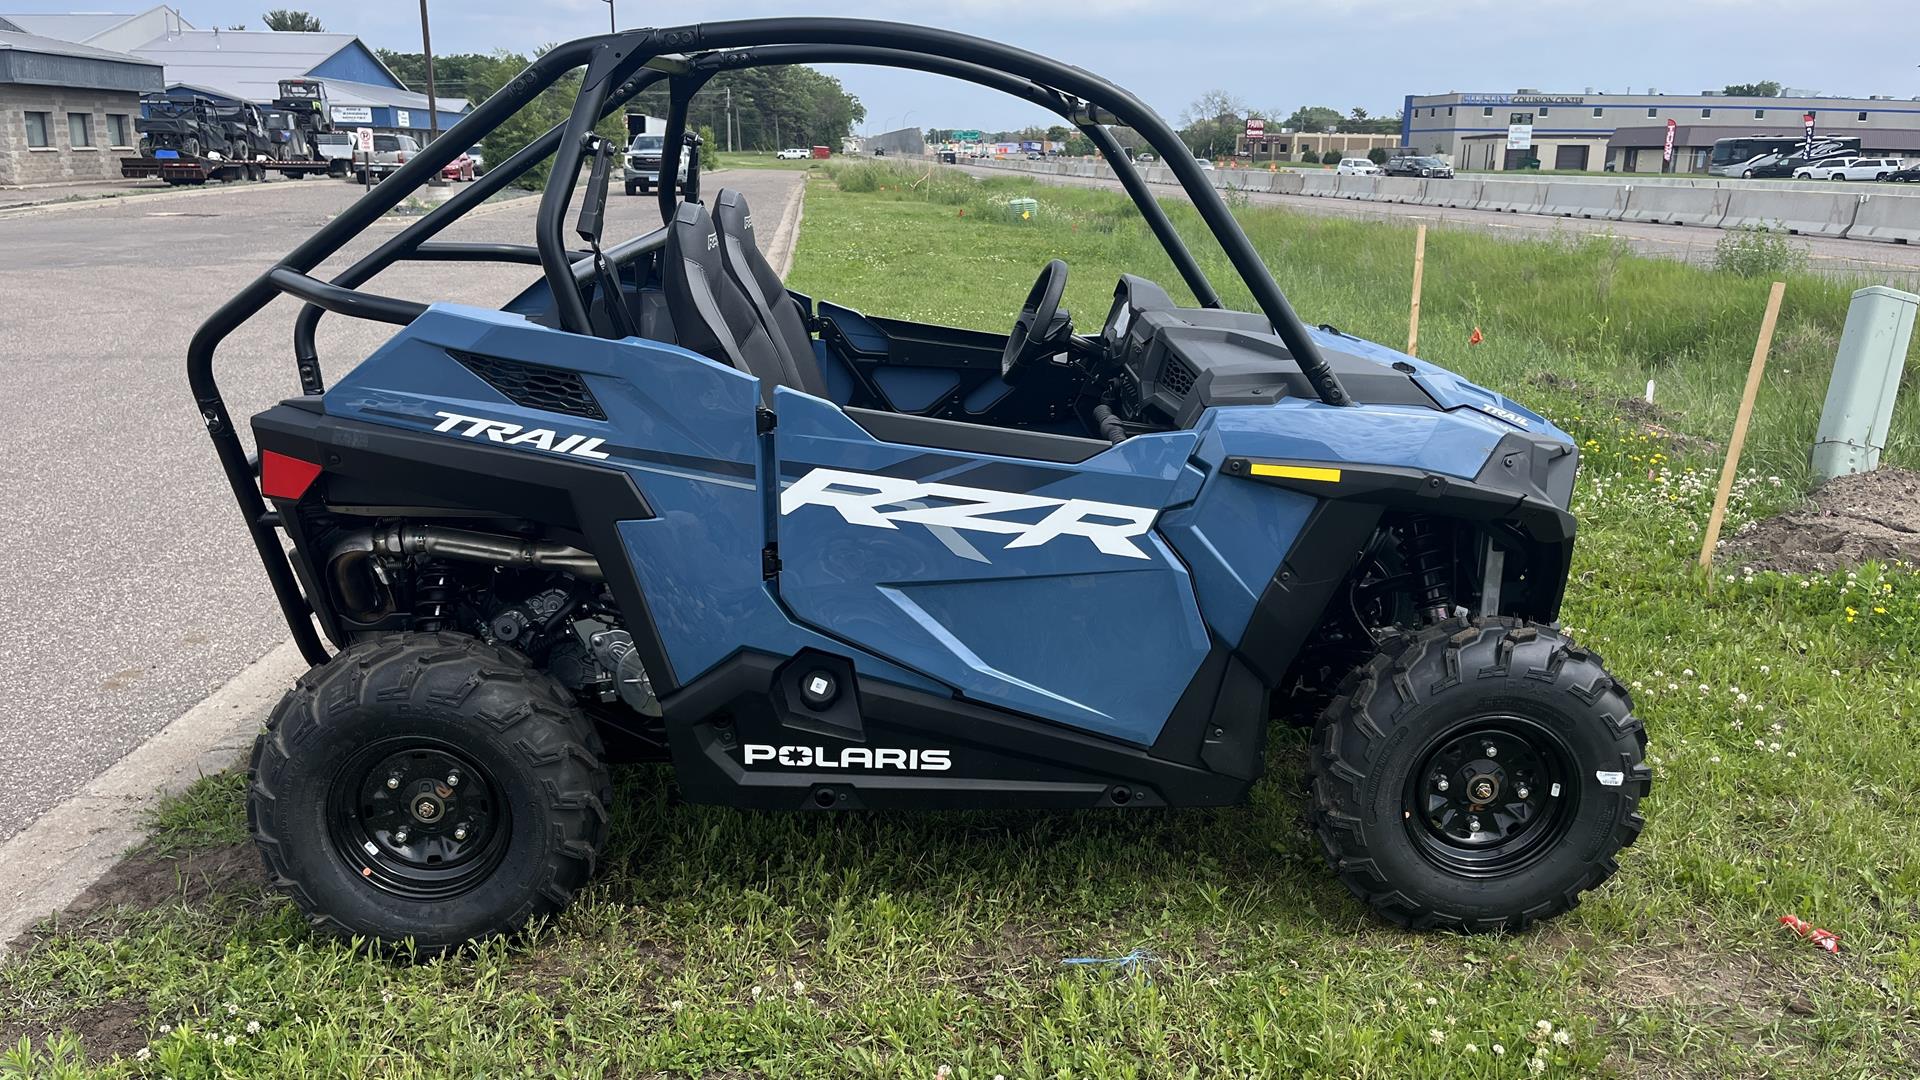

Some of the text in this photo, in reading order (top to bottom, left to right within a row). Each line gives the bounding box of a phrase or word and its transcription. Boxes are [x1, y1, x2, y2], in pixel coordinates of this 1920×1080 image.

[1555, 96, 1584, 105] CENTER
[1247, 119, 1264, 128] PAWN
[1483, 403, 1529, 427] TRAIL
[432, 411, 611, 460] TRAIL
[780, 467, 1159, 560] RZR
[744, 744, 952, 770] POLARIS
